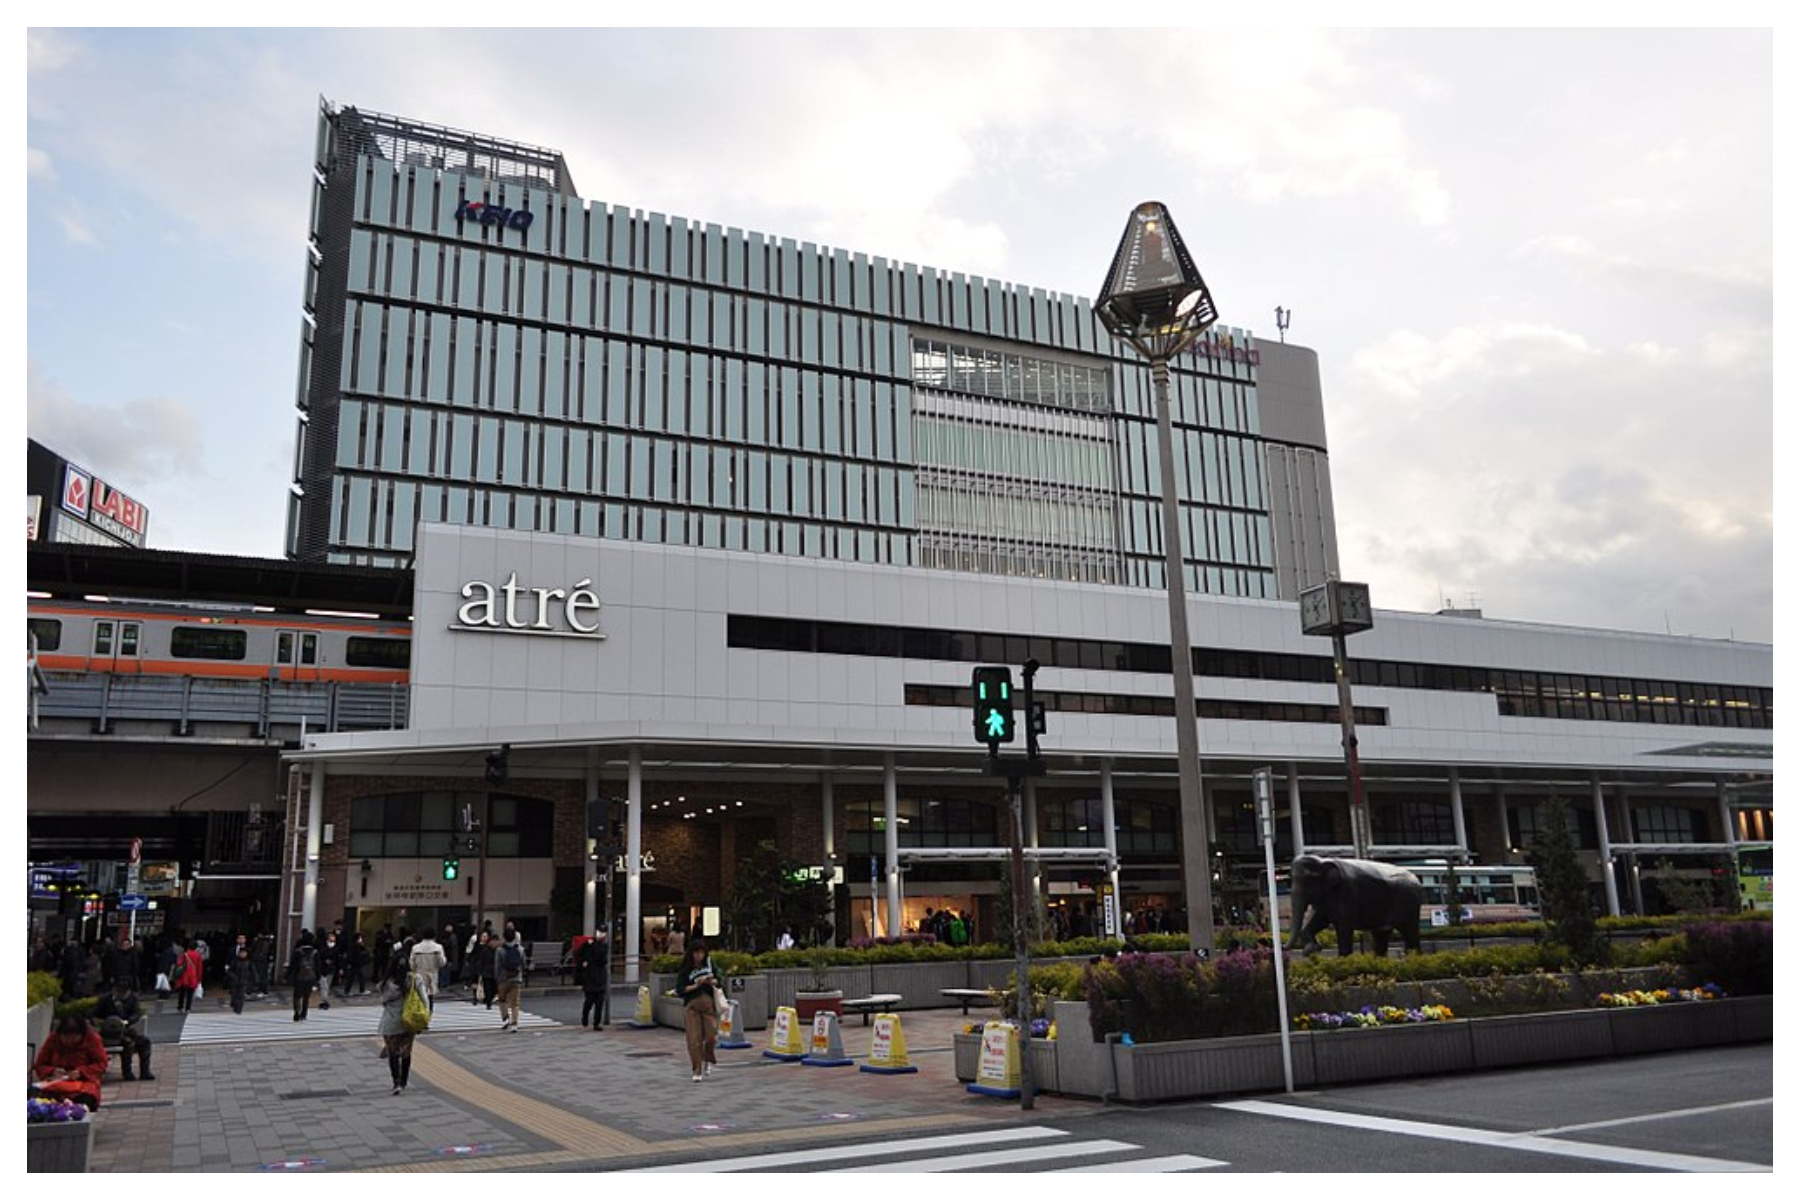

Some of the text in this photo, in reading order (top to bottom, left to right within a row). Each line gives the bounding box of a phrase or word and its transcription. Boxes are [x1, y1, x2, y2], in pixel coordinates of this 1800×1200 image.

[454, 199, 535, 231] KEIO
[92, 478, 144, 534] LABI
[457, 569, 602, 634] atré
